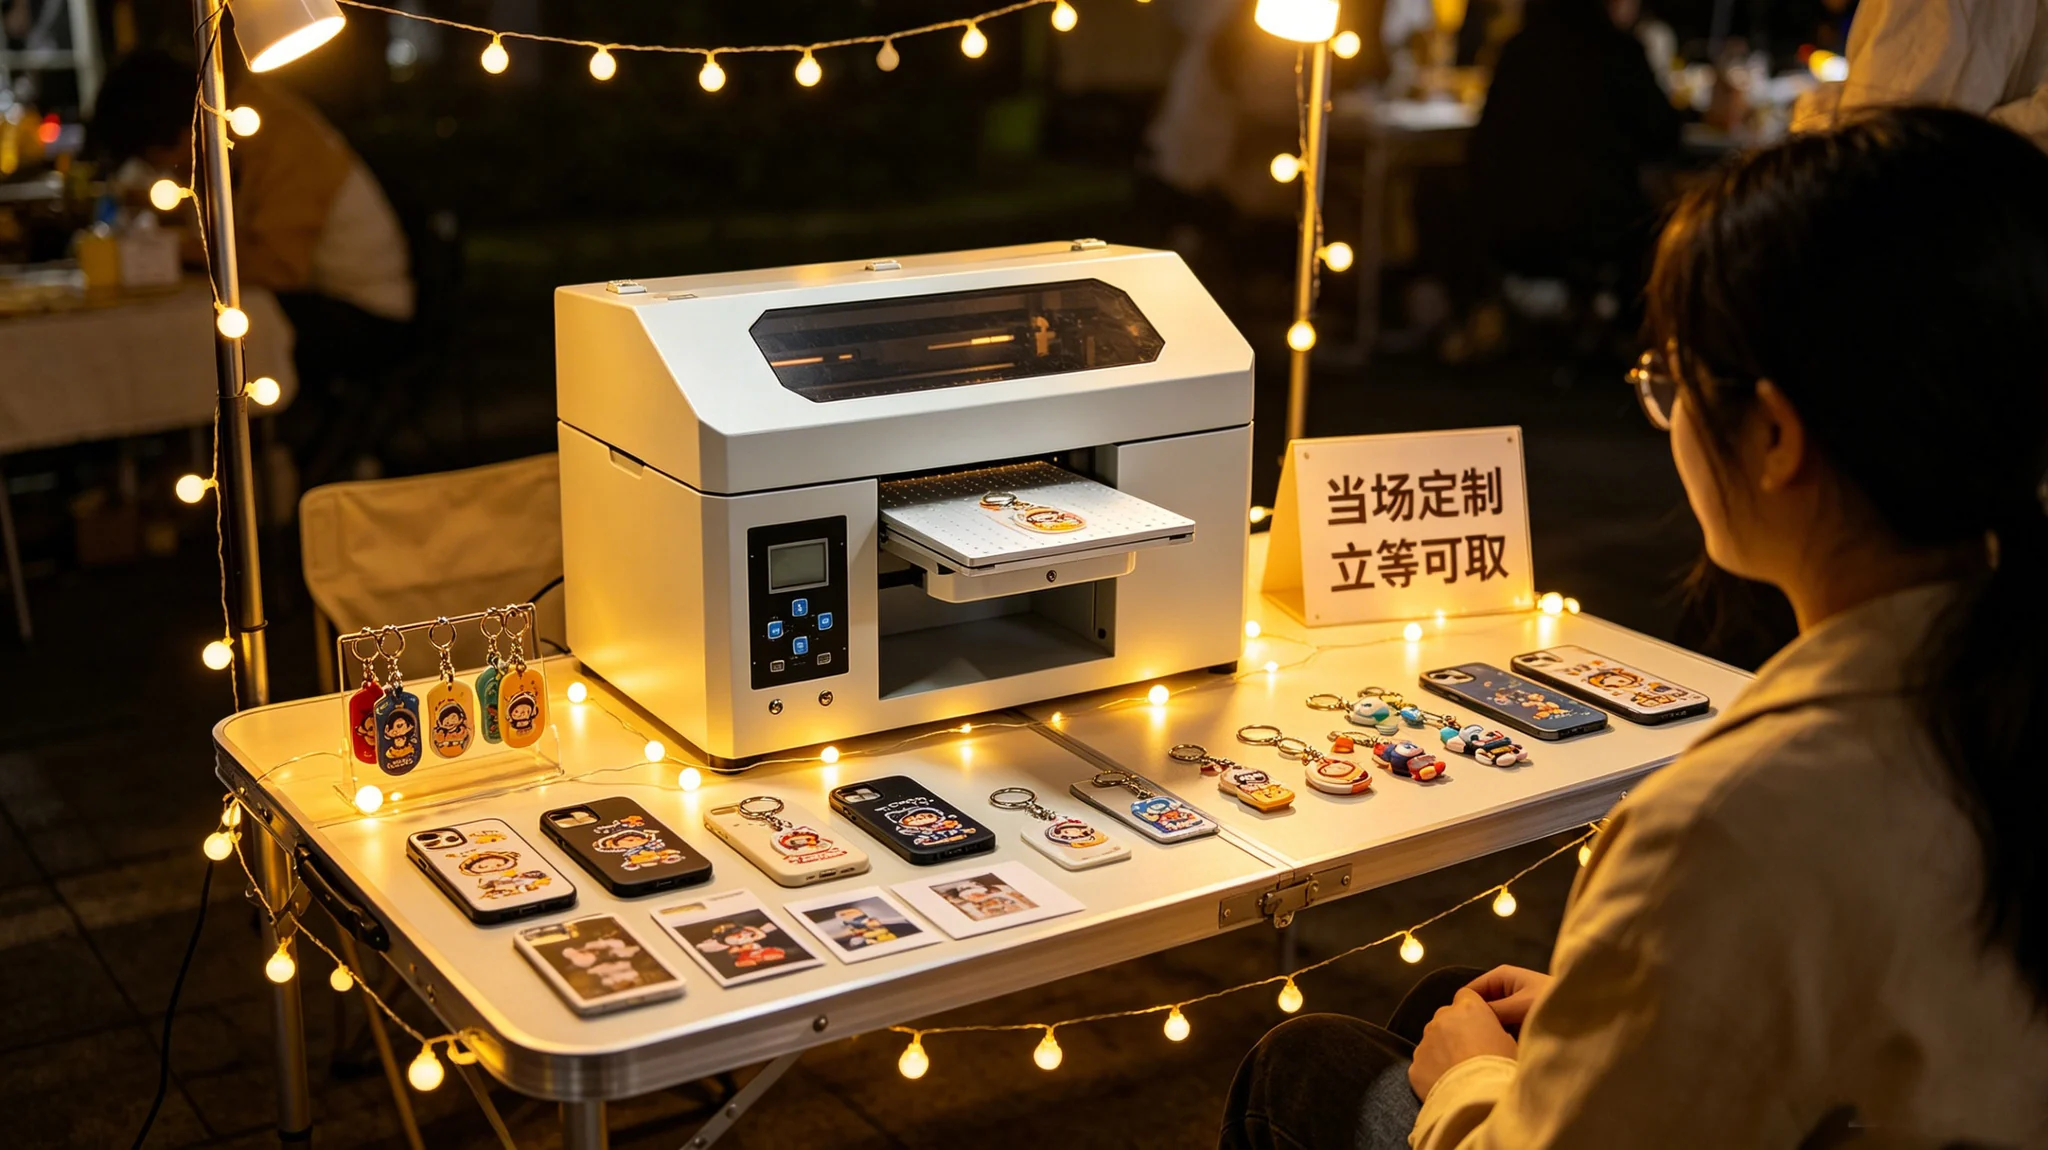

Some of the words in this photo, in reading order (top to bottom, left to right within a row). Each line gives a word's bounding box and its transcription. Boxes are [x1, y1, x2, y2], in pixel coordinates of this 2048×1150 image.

[1327, 466, 1503, 526] 当场定制
[1331, 534, 1509, 592] 立等可取
